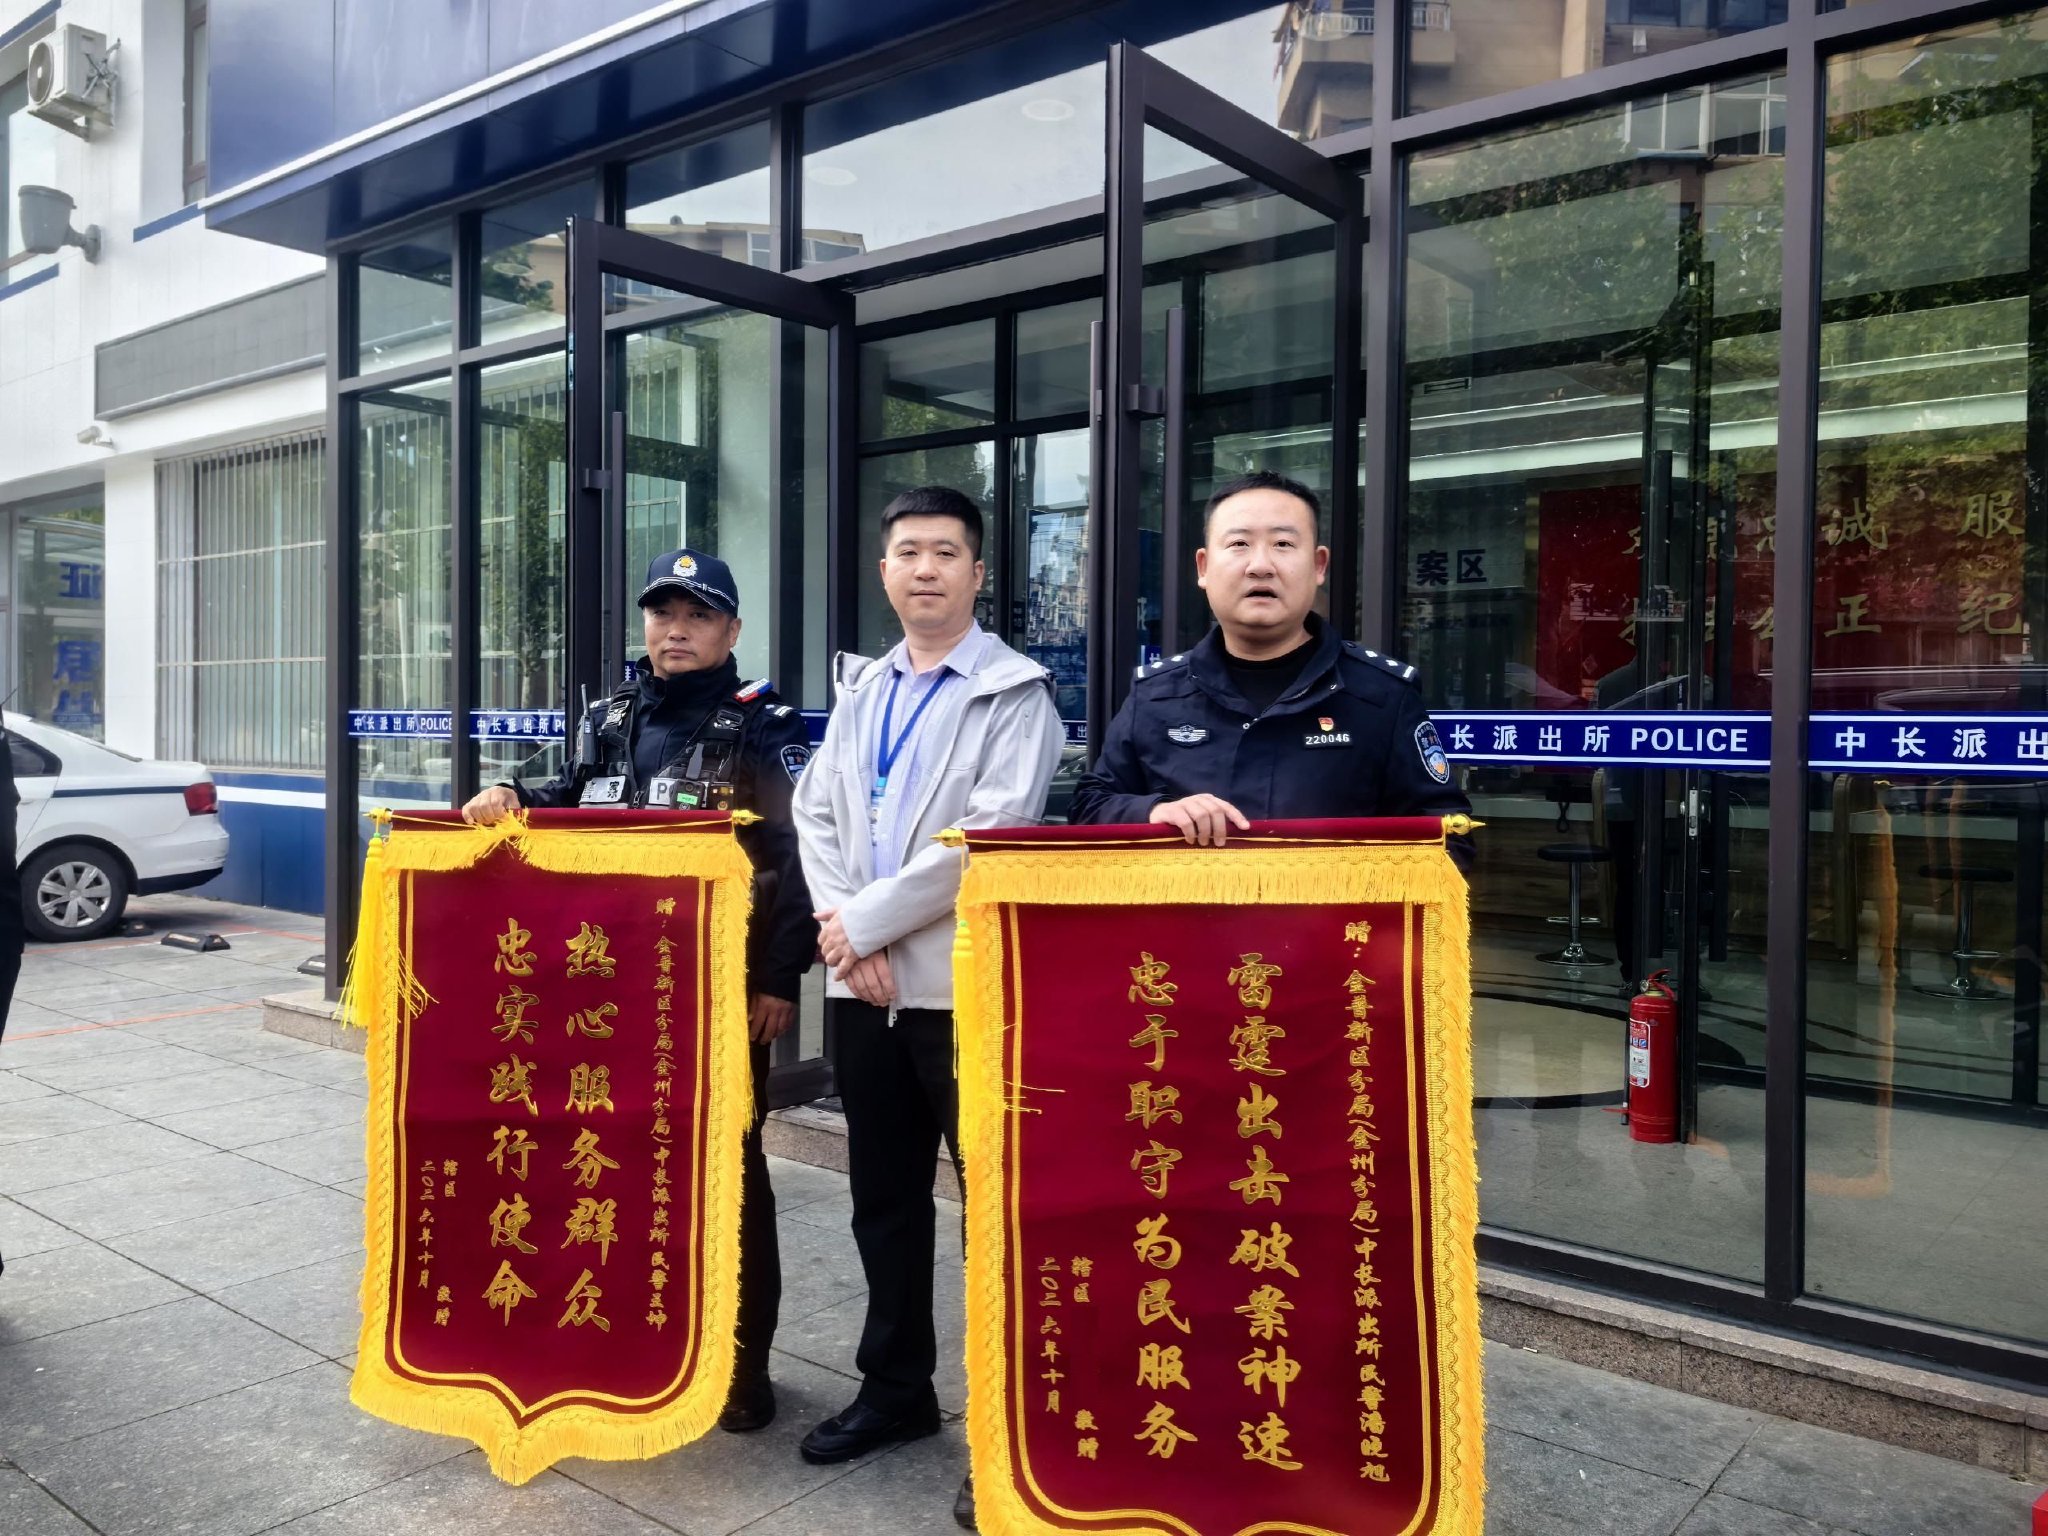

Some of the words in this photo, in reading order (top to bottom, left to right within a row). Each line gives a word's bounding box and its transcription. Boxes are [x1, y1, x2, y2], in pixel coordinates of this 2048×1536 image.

[354, 715, 417, 731] 中长派出所
[477, 716, 549, 734] 中长派出所
[1305, 734, 1350, 745] 220046
[1450, 724, 1610, 752] 长派出所
[1631, 728, 1748, 752] POLICE
[1835, 726, 2048, 760] 中长派出
[482, 918, 539, 1326] 忠实践行使命
[558, 922, 620, 1332] 热心服务群众
[1126, 952, 1198, 1458] 忠于职守为民服务
[1228, 953, 1303, 1470] 雷霆出击破案神速
